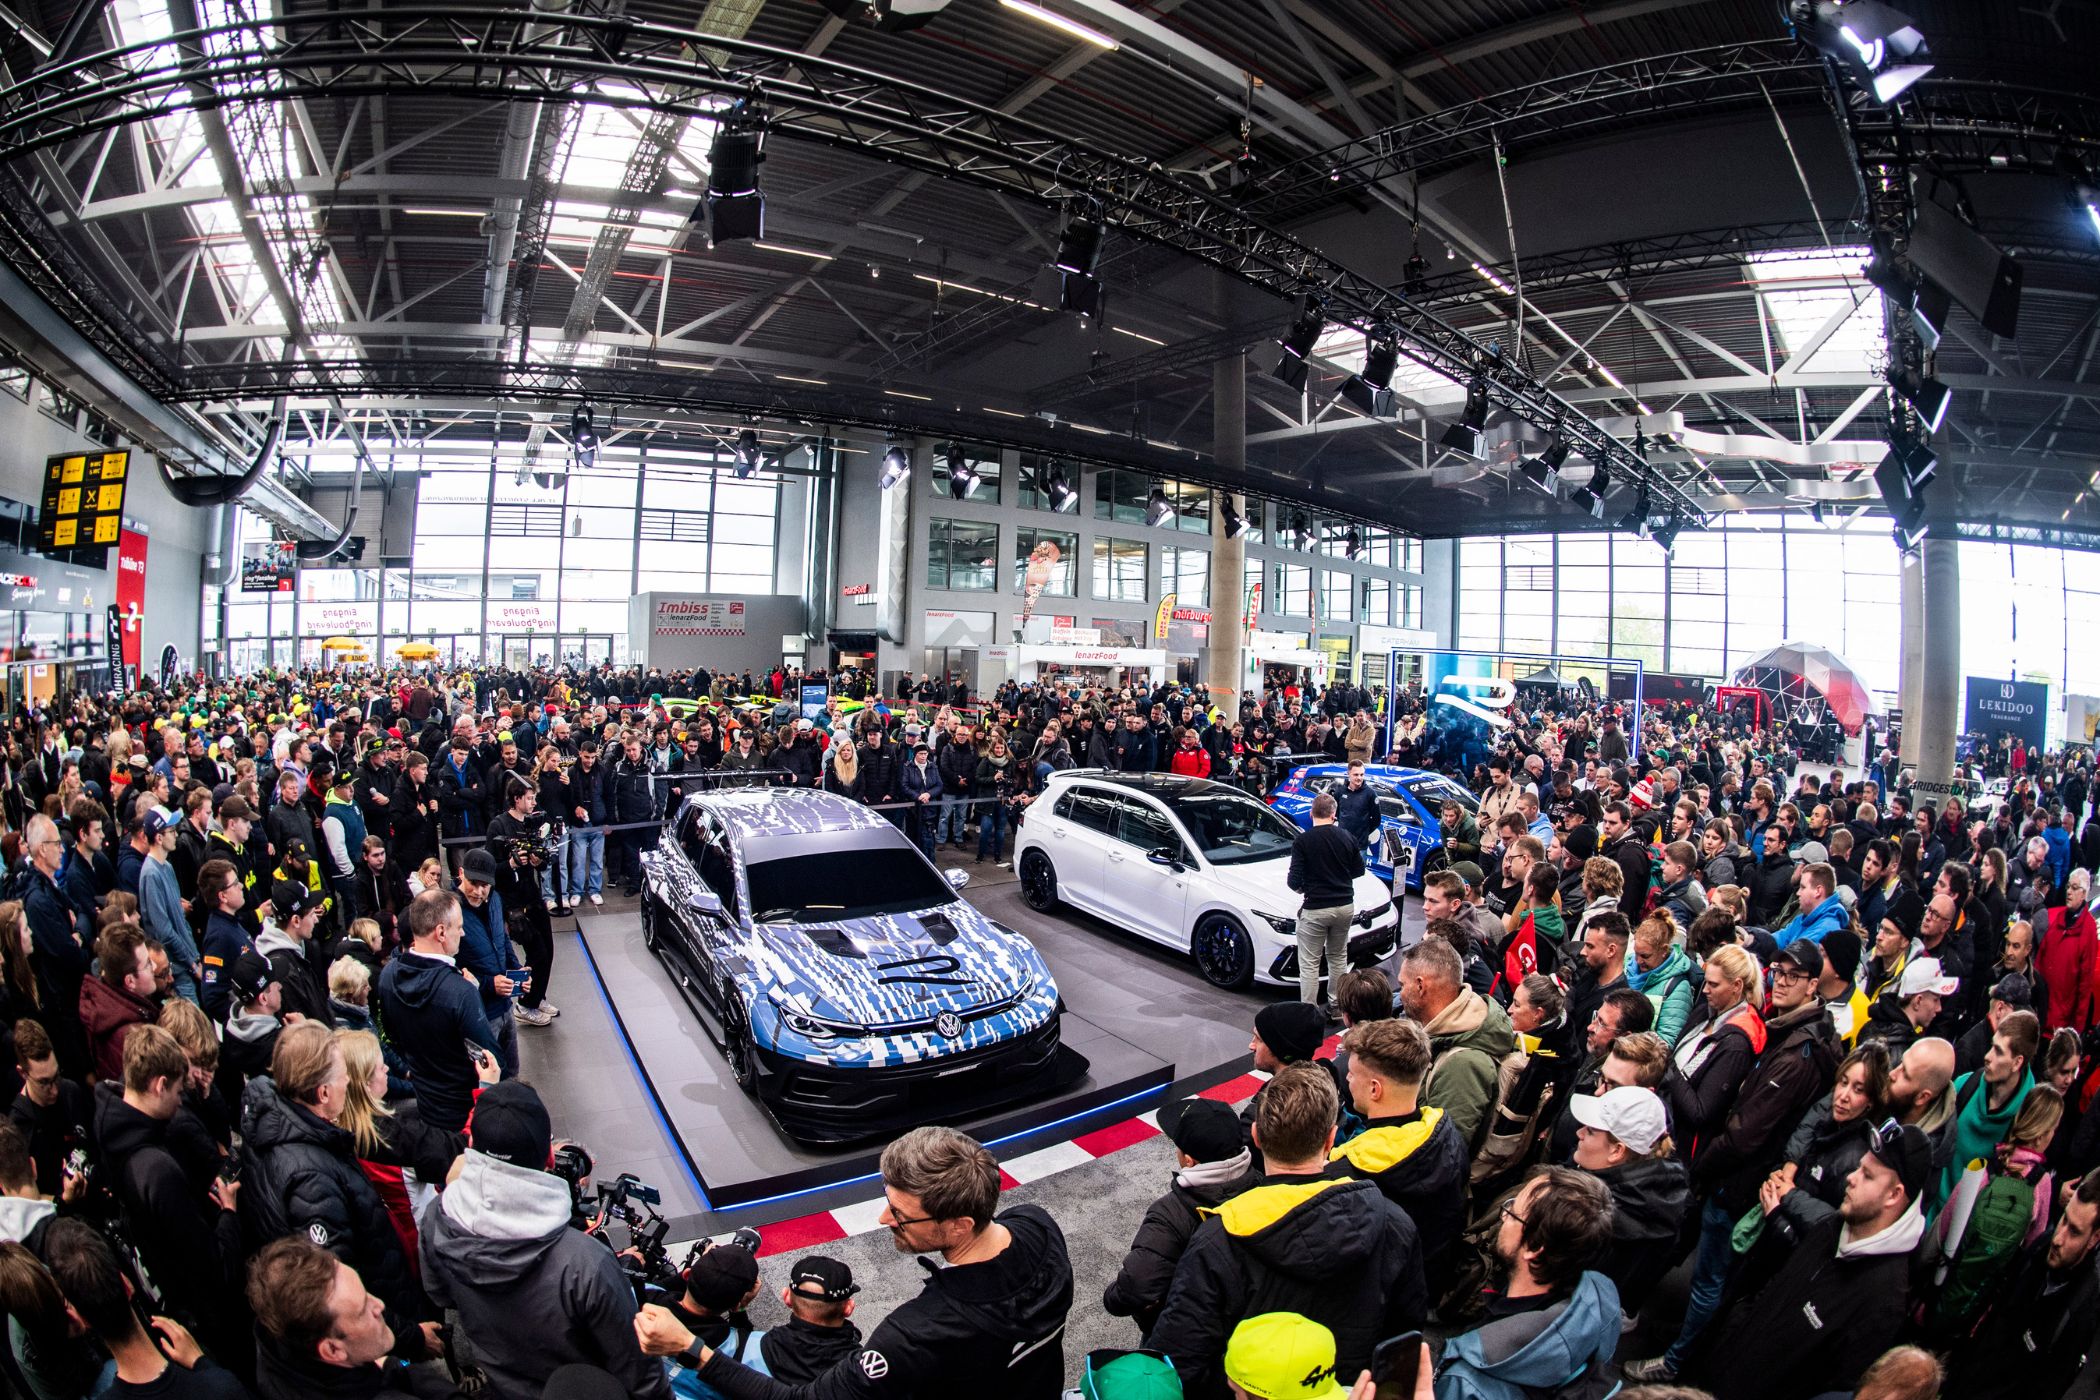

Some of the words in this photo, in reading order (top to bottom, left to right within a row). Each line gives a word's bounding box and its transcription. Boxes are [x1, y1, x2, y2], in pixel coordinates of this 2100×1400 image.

[658, 602, 708, 613] Imbiss
[1249, 591, 1259, 624] PIZZA
[126, 602, 138, 632] 2
[1075, 651, 1118, 660] lenarzFood
[1979, 699, 2034, 714] LEKIDOO
[1991, 713, 2021, 721] FRAGRANCE
